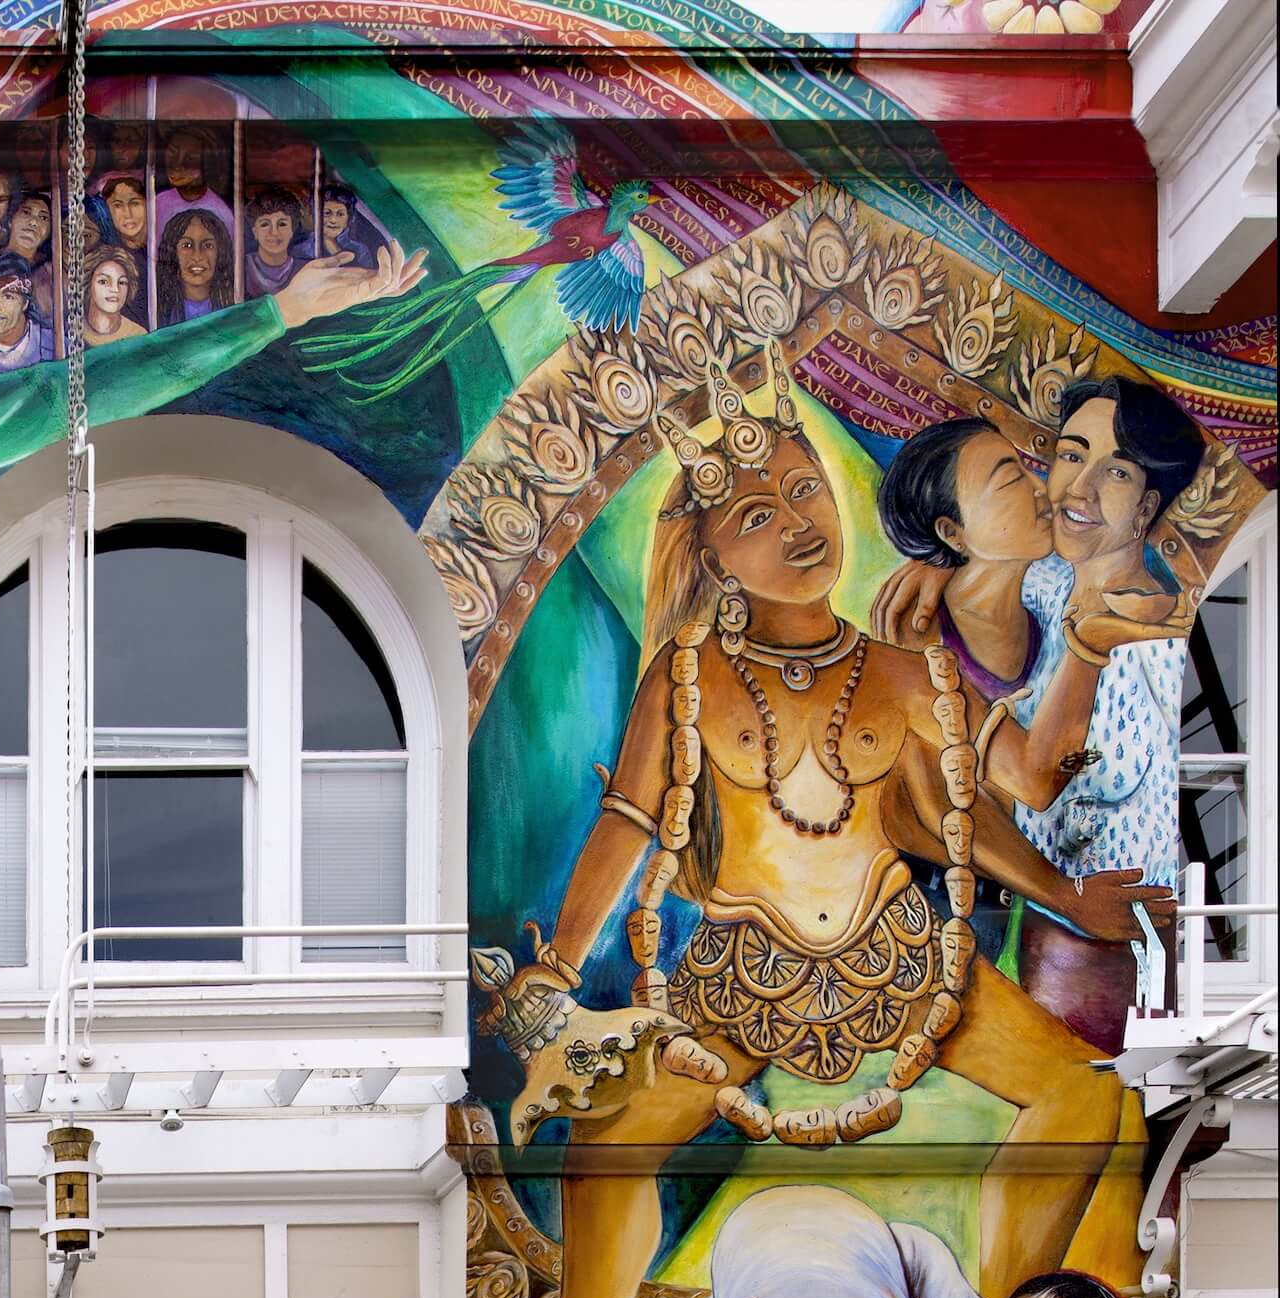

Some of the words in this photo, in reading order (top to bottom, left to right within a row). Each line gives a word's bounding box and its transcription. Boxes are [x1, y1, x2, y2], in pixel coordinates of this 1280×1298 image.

[798, 375, 845, 410] AIKO
[841, 340, 891, 379] JANE
[895, 376, 948, 415] RULE
